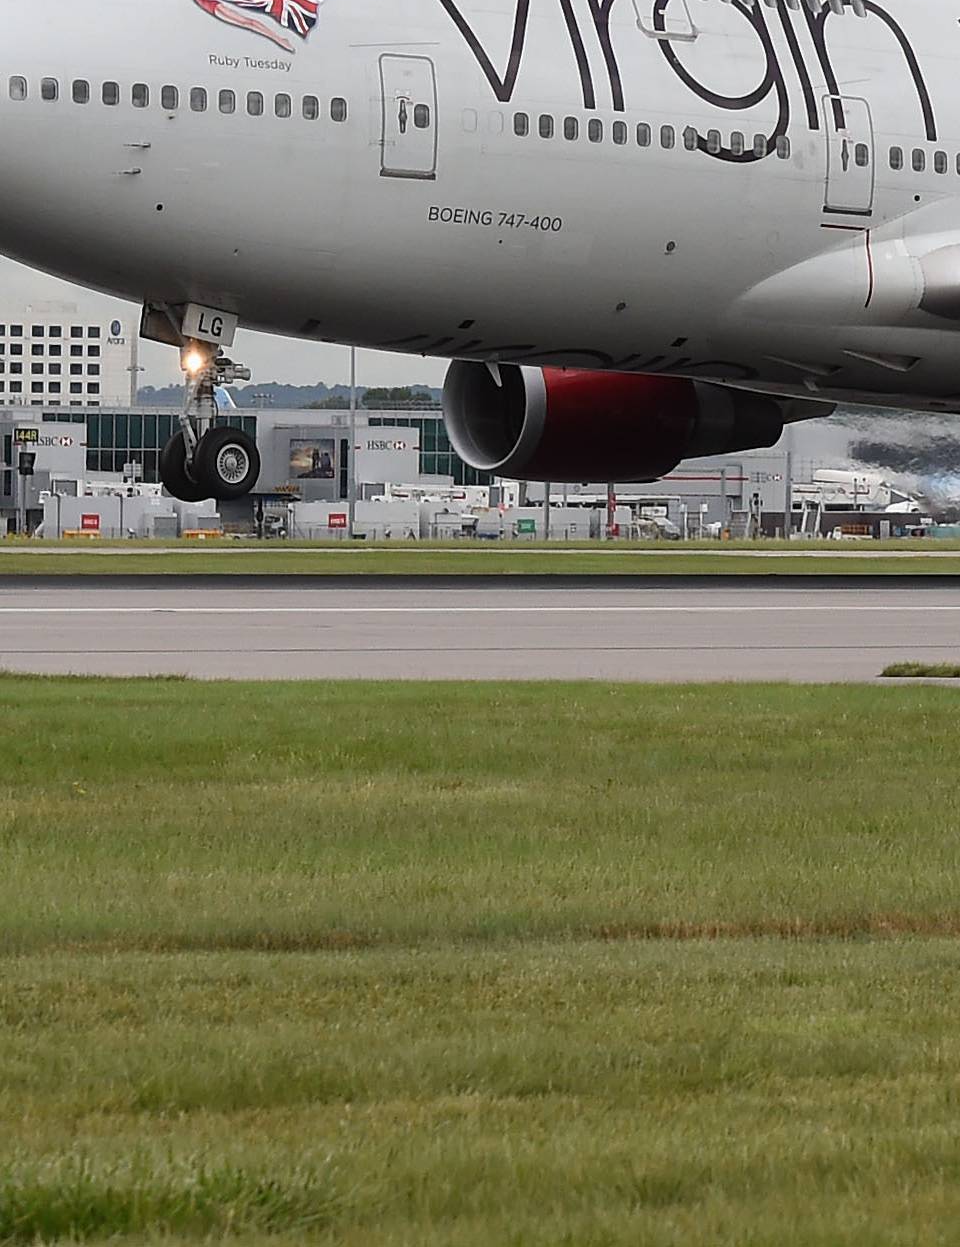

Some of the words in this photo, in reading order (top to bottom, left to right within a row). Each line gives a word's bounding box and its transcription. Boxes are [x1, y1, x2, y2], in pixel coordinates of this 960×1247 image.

[208, 54, 240, 69] Ruby
[243, 56, 292, 73] Tuesday
[428, 206, 493, 226] BOEING
[498, 212, 563, 232] 747-400
[198, 313, 223, 337] LG
[367, 440, 393, 451] HSBC
